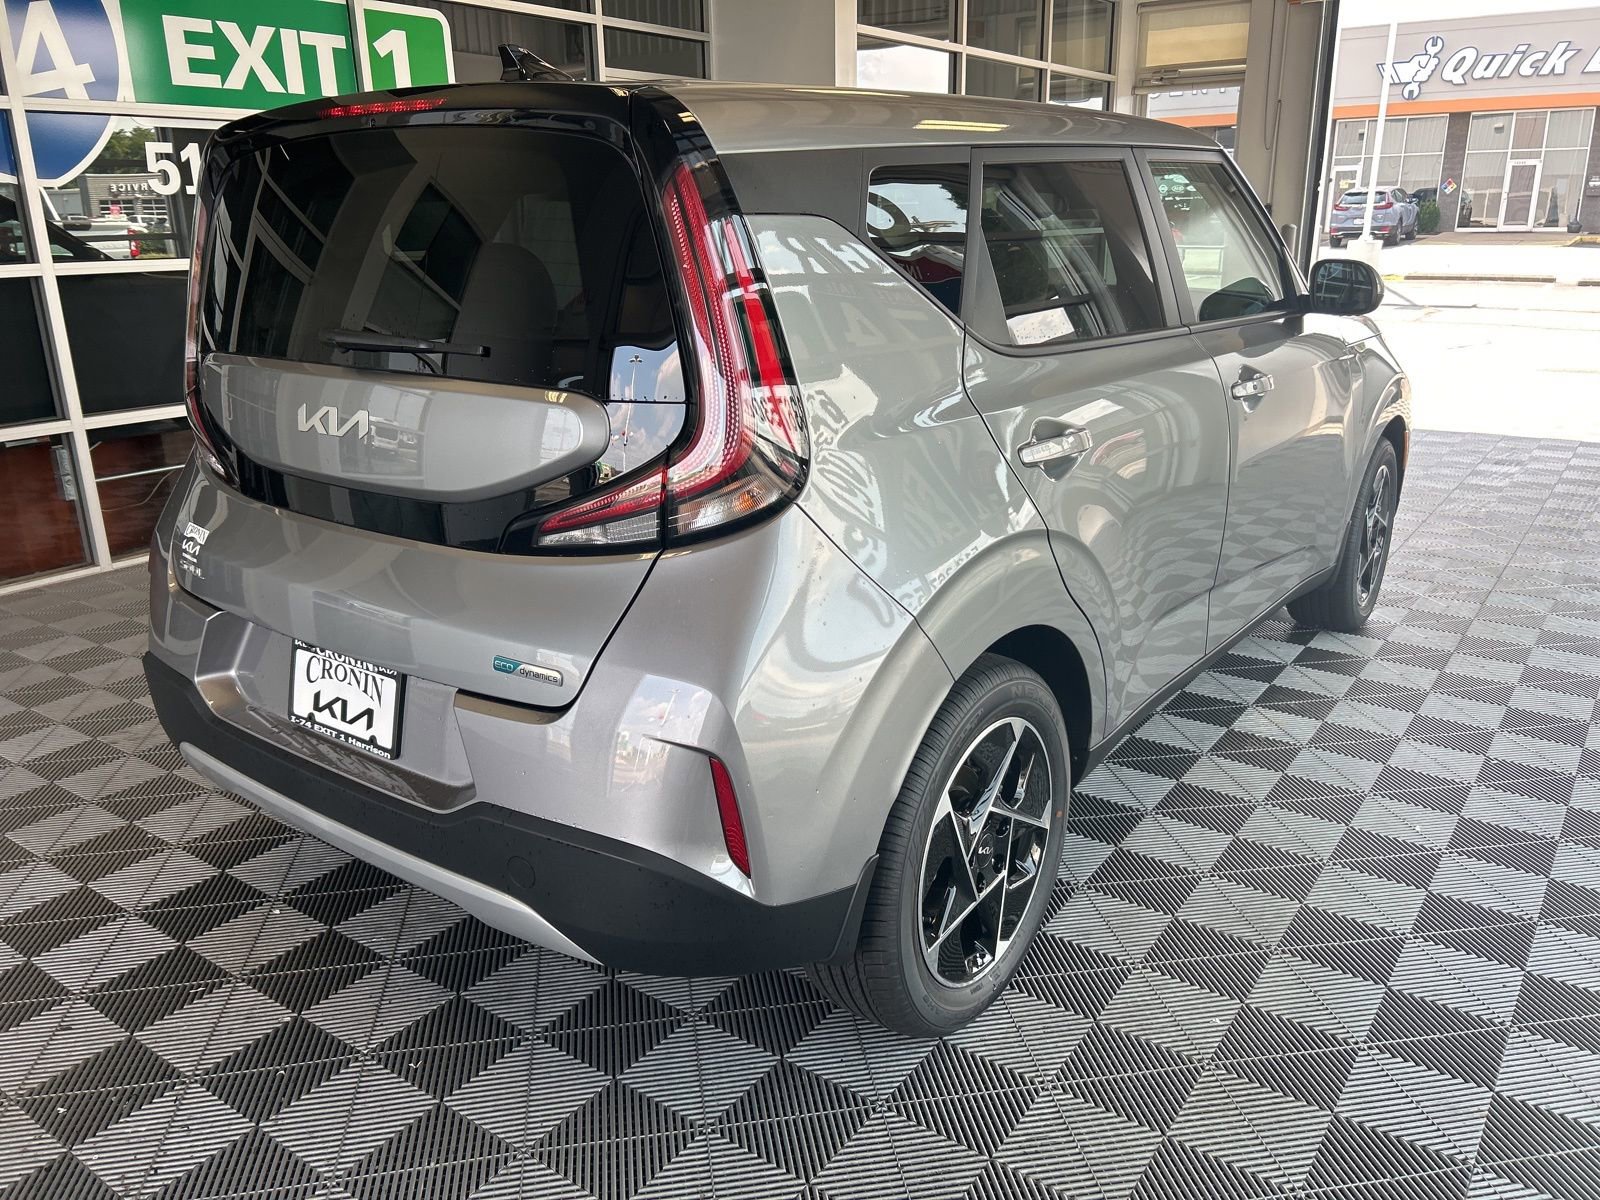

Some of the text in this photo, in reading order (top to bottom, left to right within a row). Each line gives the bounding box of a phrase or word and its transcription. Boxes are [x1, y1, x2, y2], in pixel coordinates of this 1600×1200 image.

[162, 15, 412, 97] EXIT 1
[1441, 41, 1583, 85] Quick
[298, 403, 369, 439] KIA
[306, 655, 384, 709] CRONIN
[520, 667, 558, 683] dynamics
[313, 690, 374, 731] KIA
[290, 715, 391, 760] I-74 EXIT 1 Harrison
